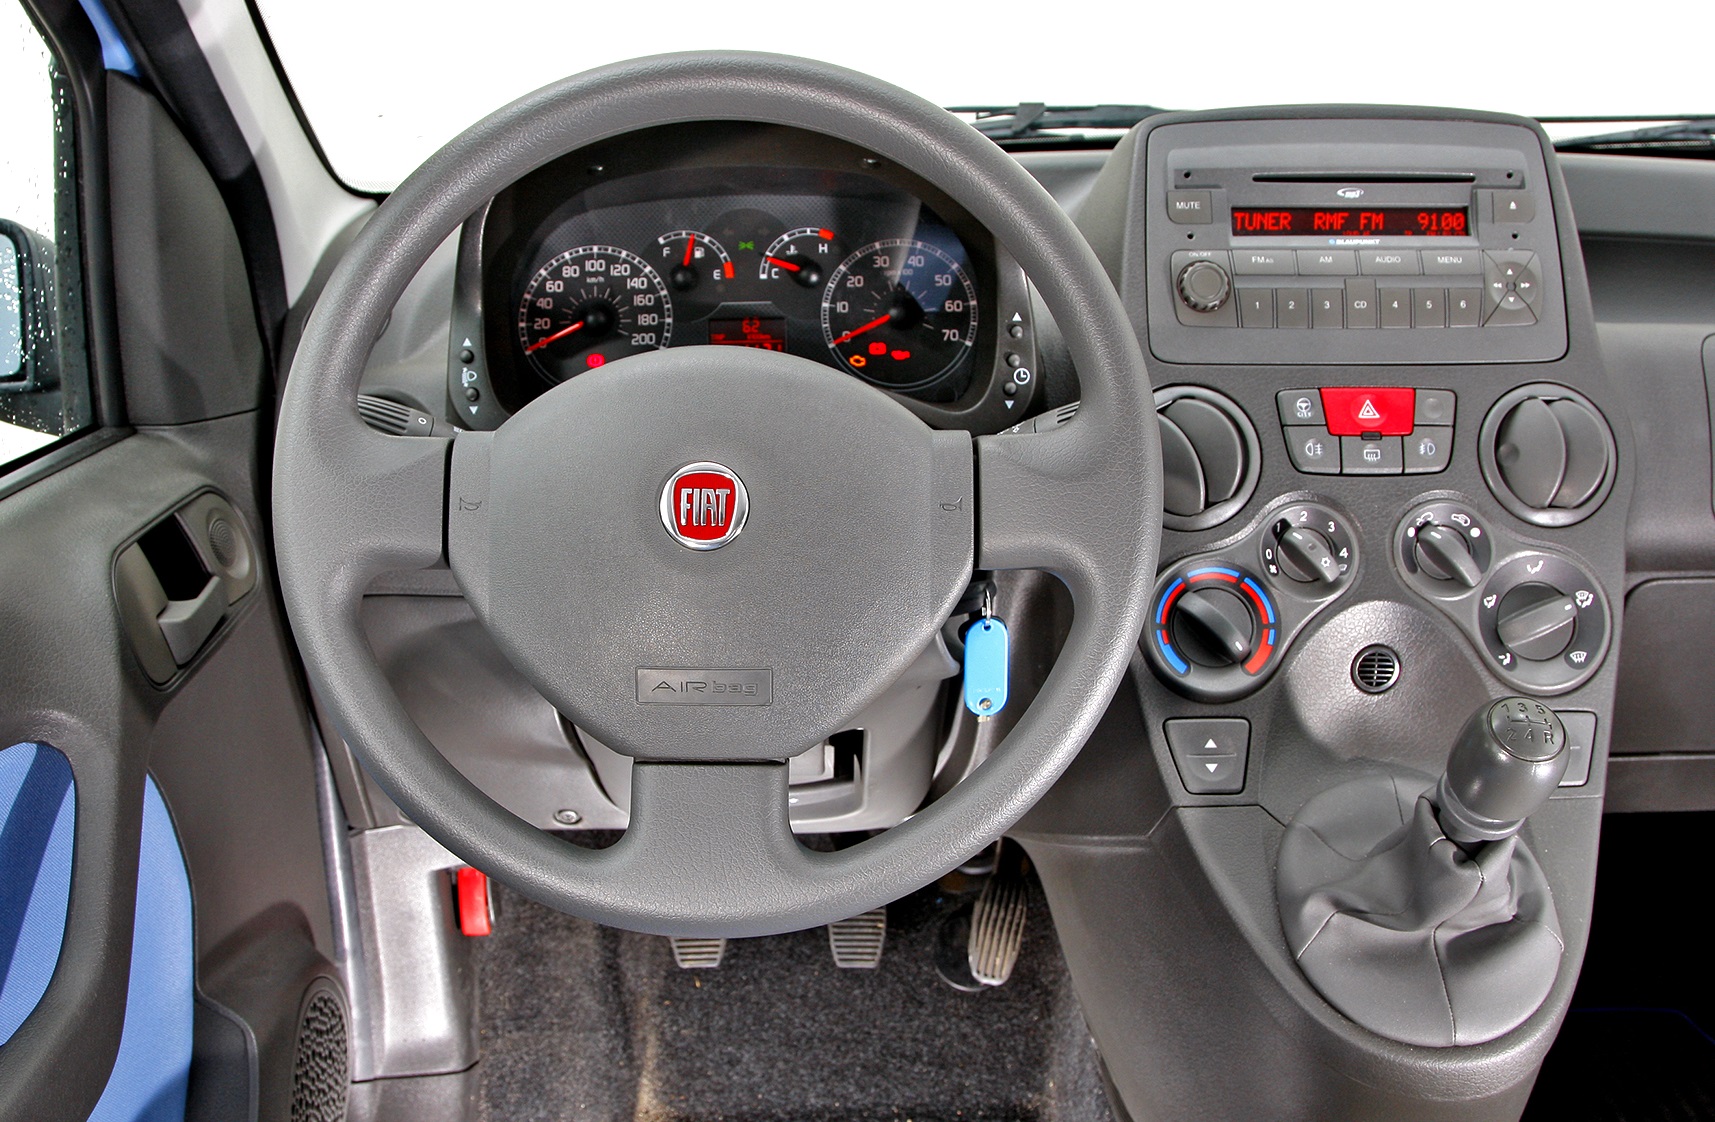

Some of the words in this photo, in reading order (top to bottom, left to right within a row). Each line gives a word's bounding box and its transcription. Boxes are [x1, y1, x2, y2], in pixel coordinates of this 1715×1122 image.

[1175, 201, 1201, 210] MUTE
[1233, 212, 1292, 230] TUNER
[1313, 212, 1350, 230] RMF
[1359, 212, 1385, 230] FM
[662, 247, 671, 257] F
[818, 243, 828, 254] H
[585, 260, 605, 272] 100
[873, 256, 890, 268] 30
[907, 256, 925, 268] 40
[562, 265, 580, 277] 80
[610, 264, 630, 276] 120
[713, 269, 721, 280] E
[771, 268, 779, 279] C
[627, 277, 647, 289] 140
[846, 275, 864, 287] 20
[934, 274, 952, 286] 50
[545, 280, 564, 292] 60
[536, 298, 553, 309] 40
[633, 294, 654, 306] 160
[1255, 301, 1260, 309] 1
[1288, 301, 1295, 309] 2
[1324, 301, 1331, 309] 3
[1354, 300, 1367, 309] CD
[1392, 301, 1398, 309] 4
[1426, 300, 1432, 309] 5
[1460, 300, 1466, 309] 6
[836, 301, 849, 313] 10
[944, 300, 963, 312] 60
[533, 318, 551, 329] 20
[637, 314, 658, 325] 180
[742, 319, 760, 333] 62
[631, 333, 655, 345] 200
[941, 329, 959, 341] 70
[680, 488, 731, 526] FIAT
[1300, 511, 1307, 521] 2
[1275, 522, 1281, 532] 1
[1328, 522, 1335, 532] 3
[1265, 549, 1273, 559] 0
[1339, 548, 1348, 558] 4
[1501, 703, 1510, 712] 1
[1517, 702, 1528, 712] 3
[1535, 704, 1546, 714] 5
[1506, 727, 1517, 742] 2
[1524, 728, 1533, 742] 4
[1543, 730, 1554, 745] R
